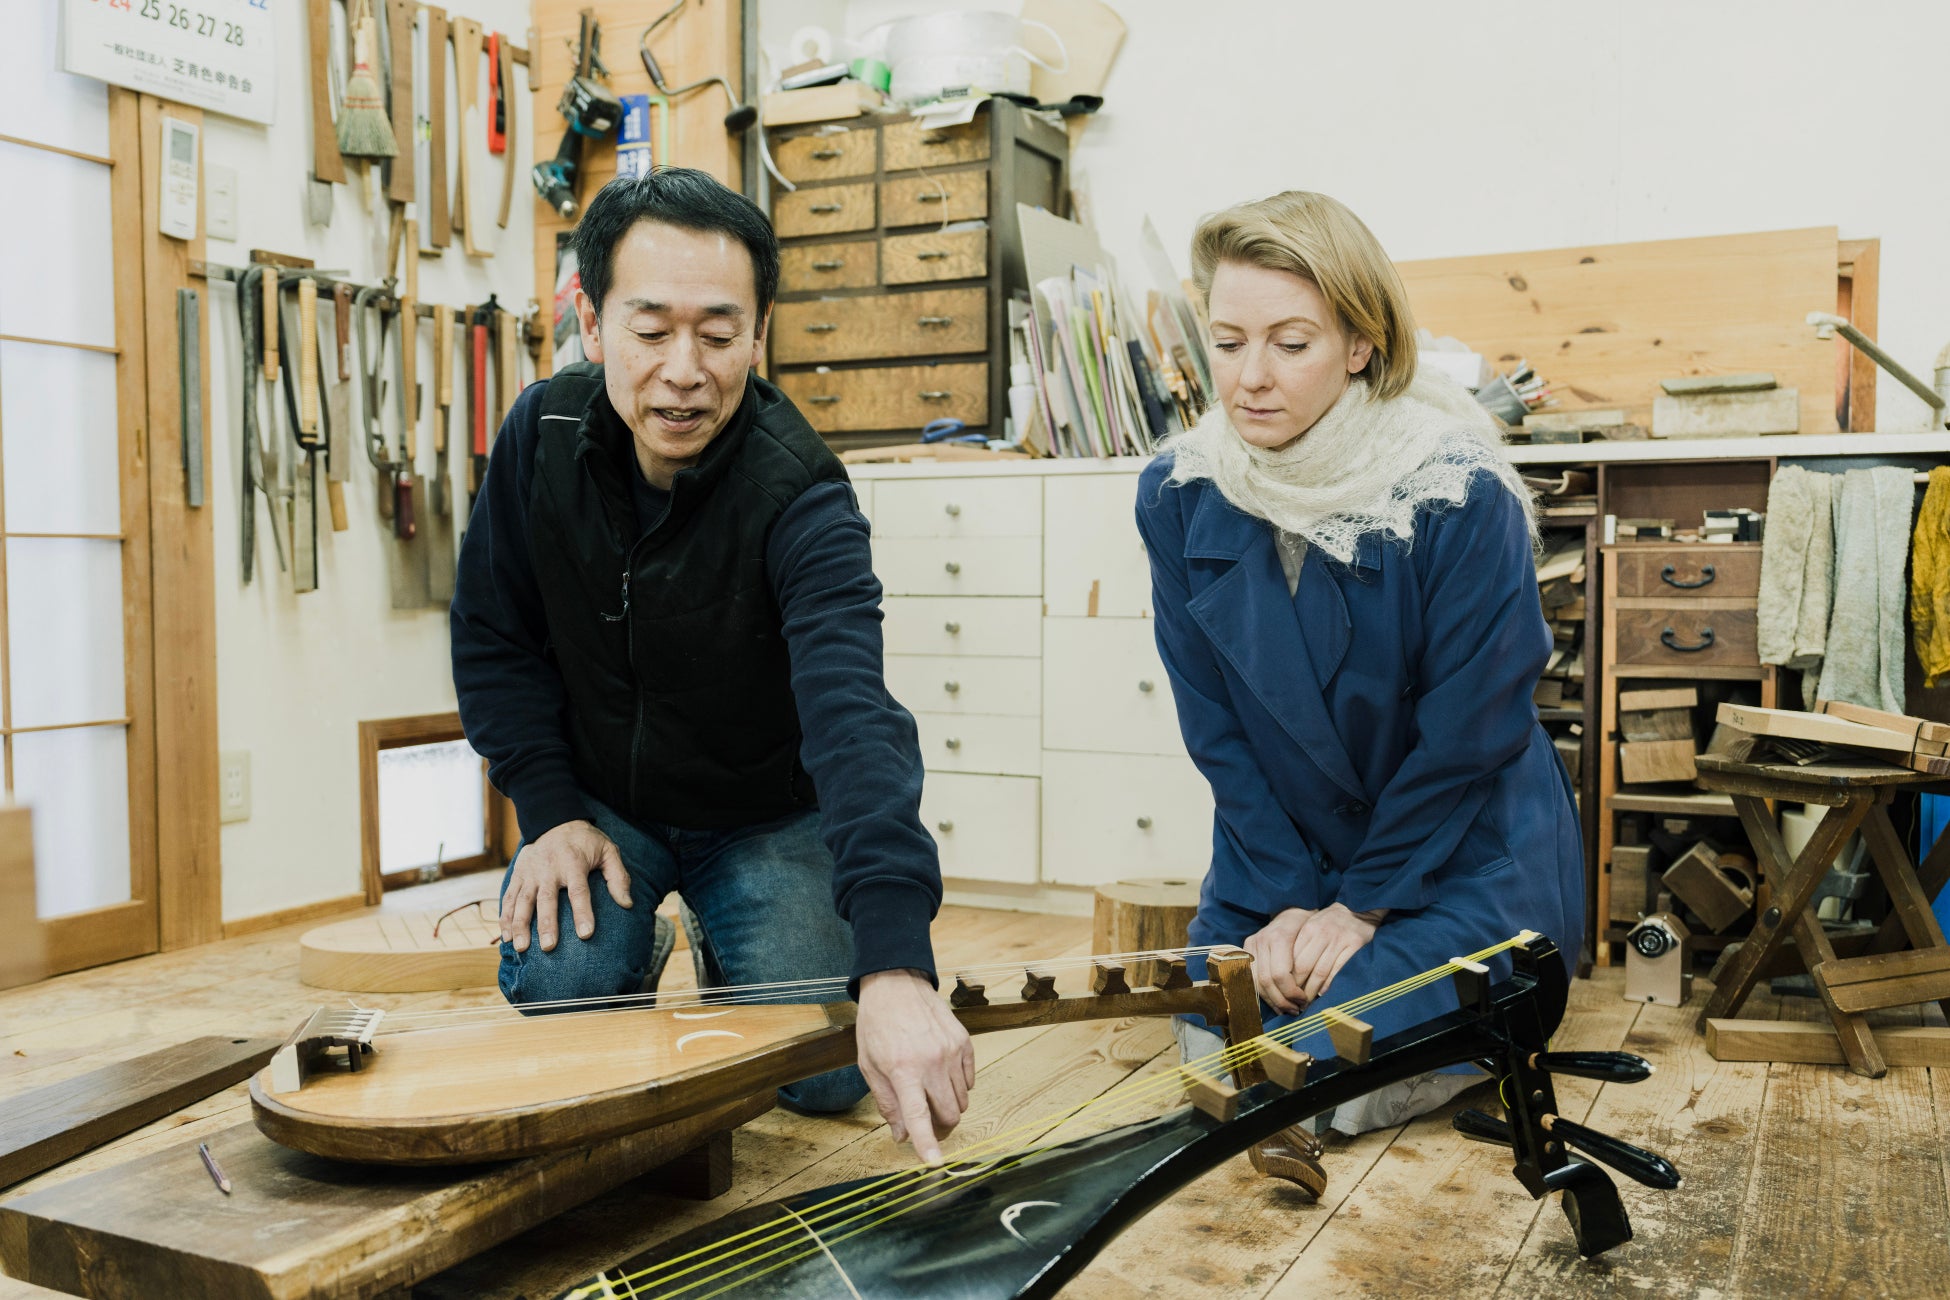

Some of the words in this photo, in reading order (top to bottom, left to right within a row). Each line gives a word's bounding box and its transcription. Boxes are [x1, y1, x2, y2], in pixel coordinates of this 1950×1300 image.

[141, 0, 160, 20] 25
[169, 5, 189, 29] 26
[197, 13, 215, 37] 27
[225, 22, 244, 46] 28
